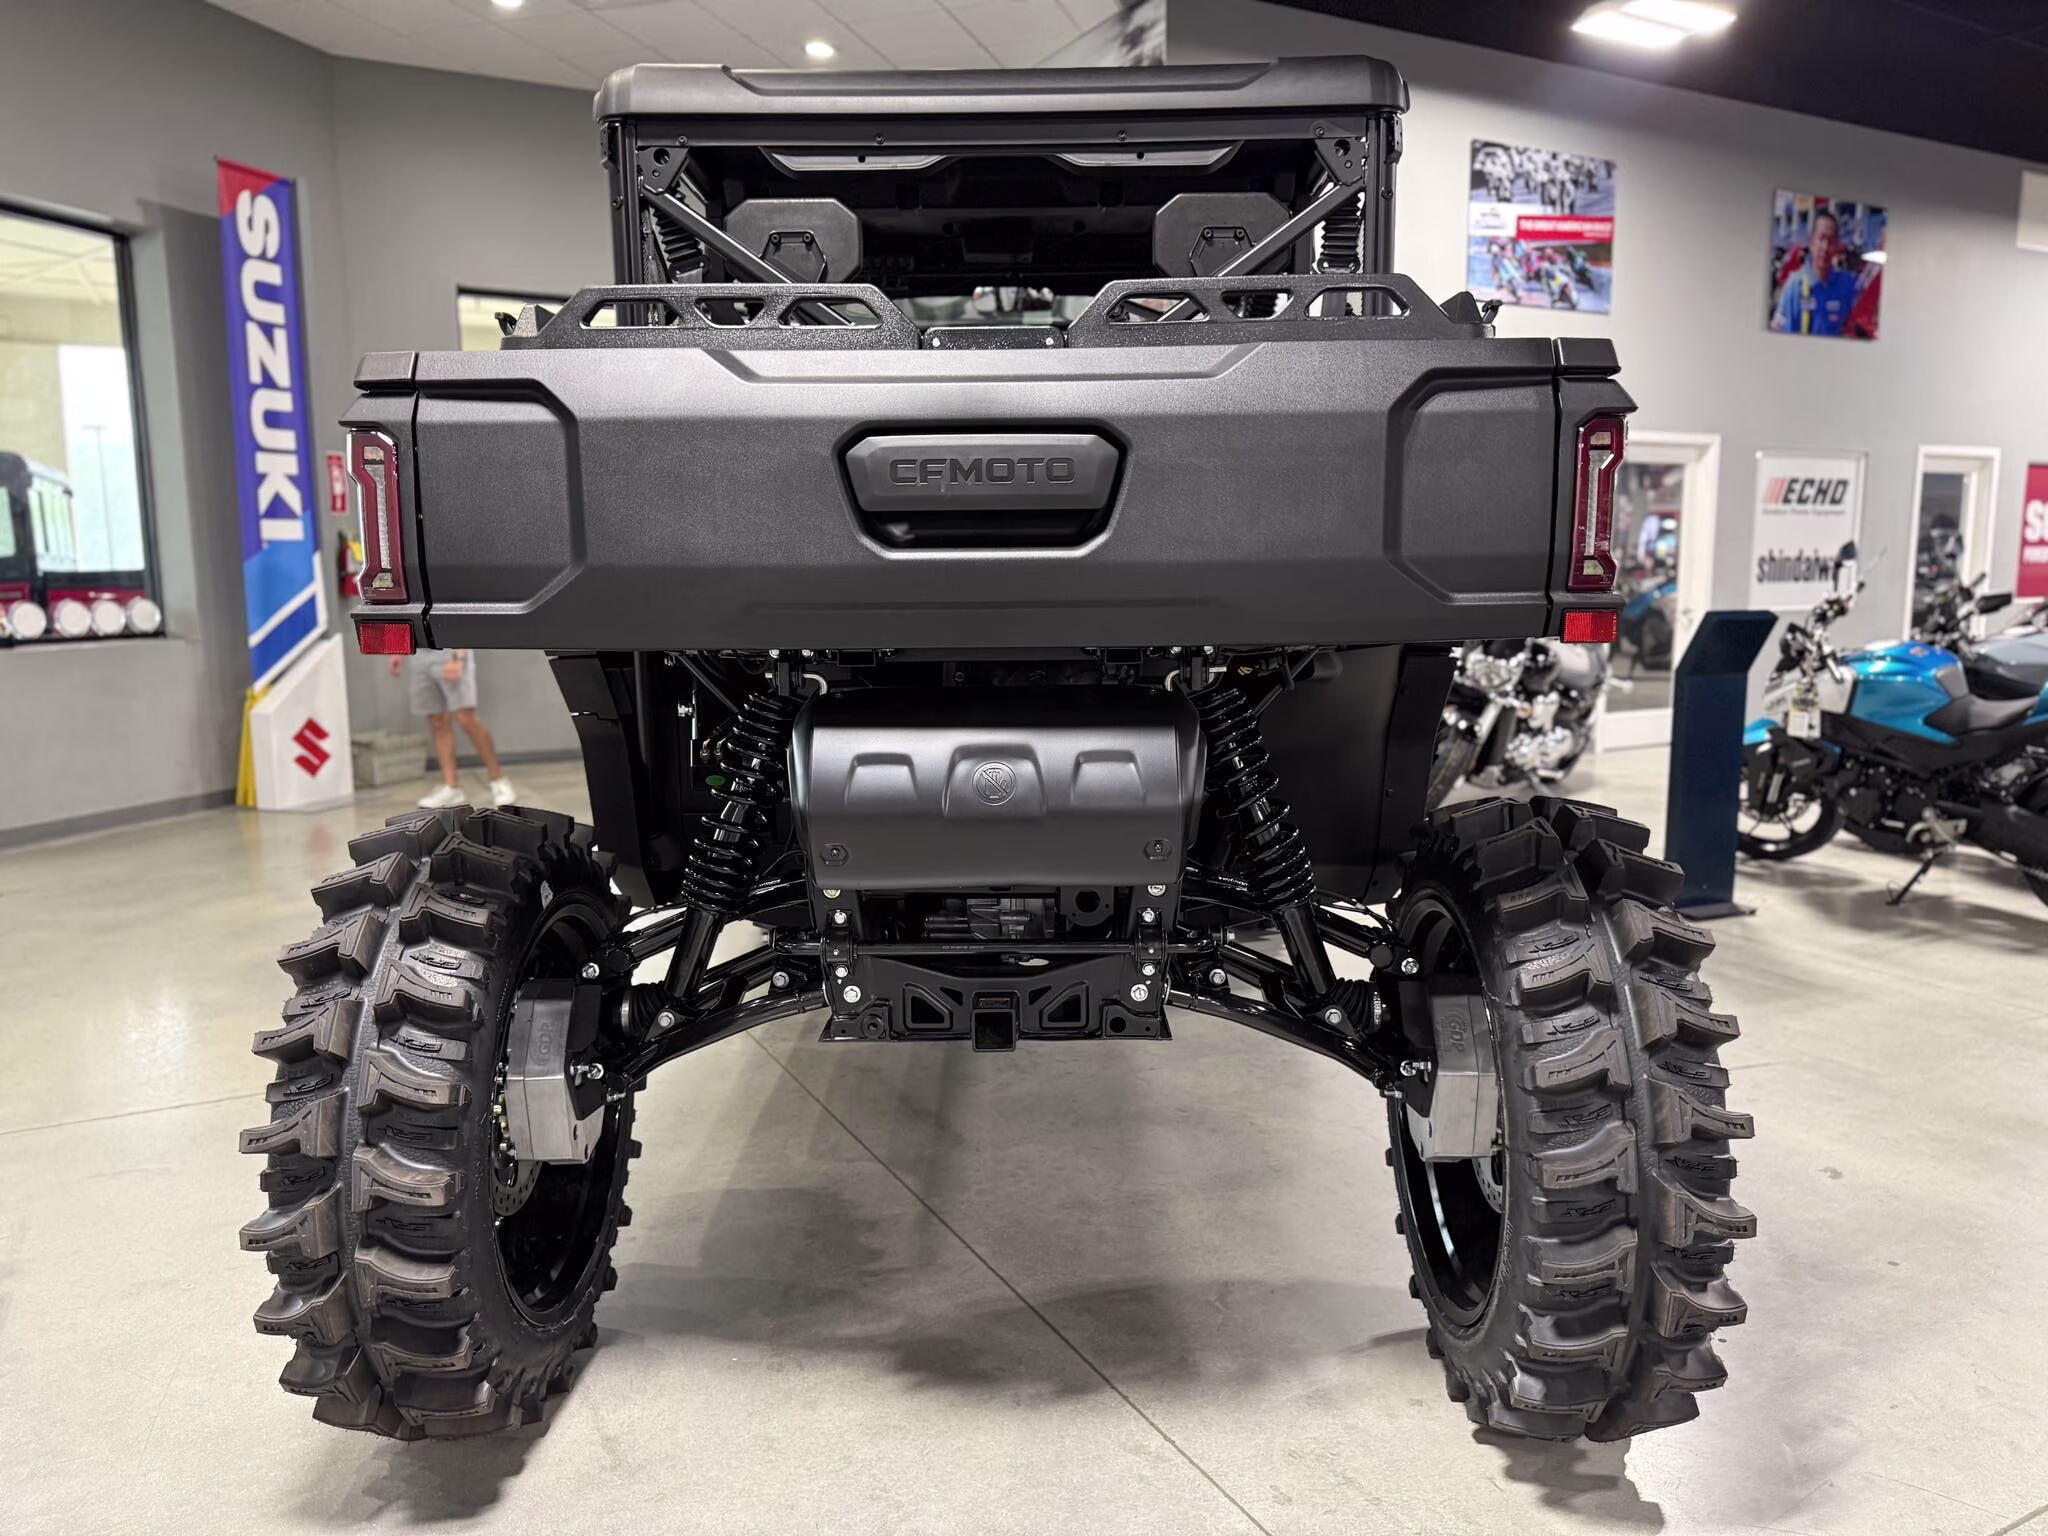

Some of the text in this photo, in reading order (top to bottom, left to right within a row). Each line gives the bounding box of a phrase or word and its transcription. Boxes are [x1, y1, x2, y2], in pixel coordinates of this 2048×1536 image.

[236, 189, 304, 542] SUZUKI
[889, 457, 1075, 485] CFMOTO
[1782, 478, 1848, 505] ECHO
[1757, 548, 1837, 583] shindaiw
